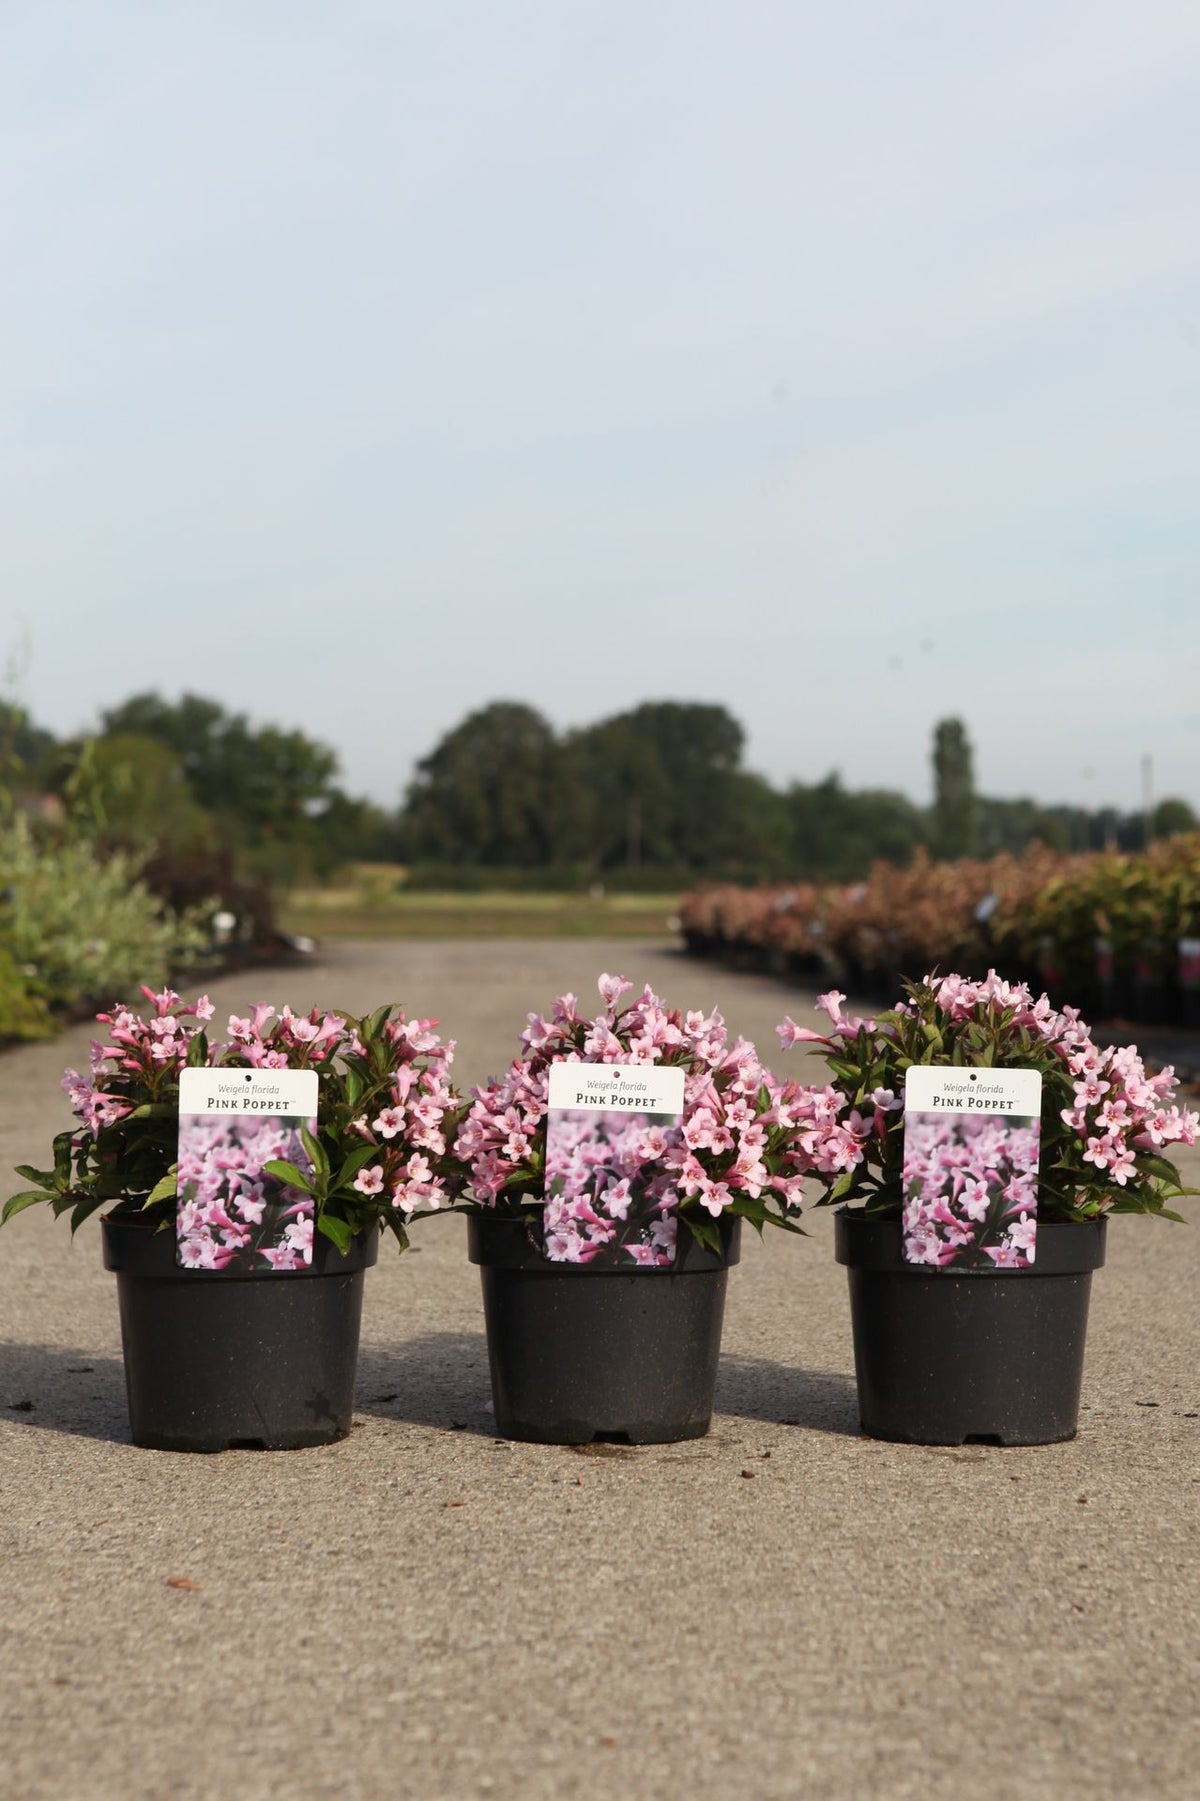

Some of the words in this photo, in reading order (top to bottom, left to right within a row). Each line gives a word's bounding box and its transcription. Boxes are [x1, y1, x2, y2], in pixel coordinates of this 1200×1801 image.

[218, 1084, 250, 1095] Weigela
[251, 1085, 280, 1095] florida
[587, 1080, 618, 1091] Weigela
[619, 1081, 647, 1092] florida
[943, 1083, 975, 1094] Weigela
[976, 1084, 1004, 1094] florida
[207, 1097, 238, 1109] PINK
[243, 1098, 290, 1110] POPPET
[576, 1093, 606, 1105] PINK
[610, 1094, 657, 1107] POPPET
[933, 1096, 963, 1108] PINK
[967, 1097, 1014, 1109] POPPET
